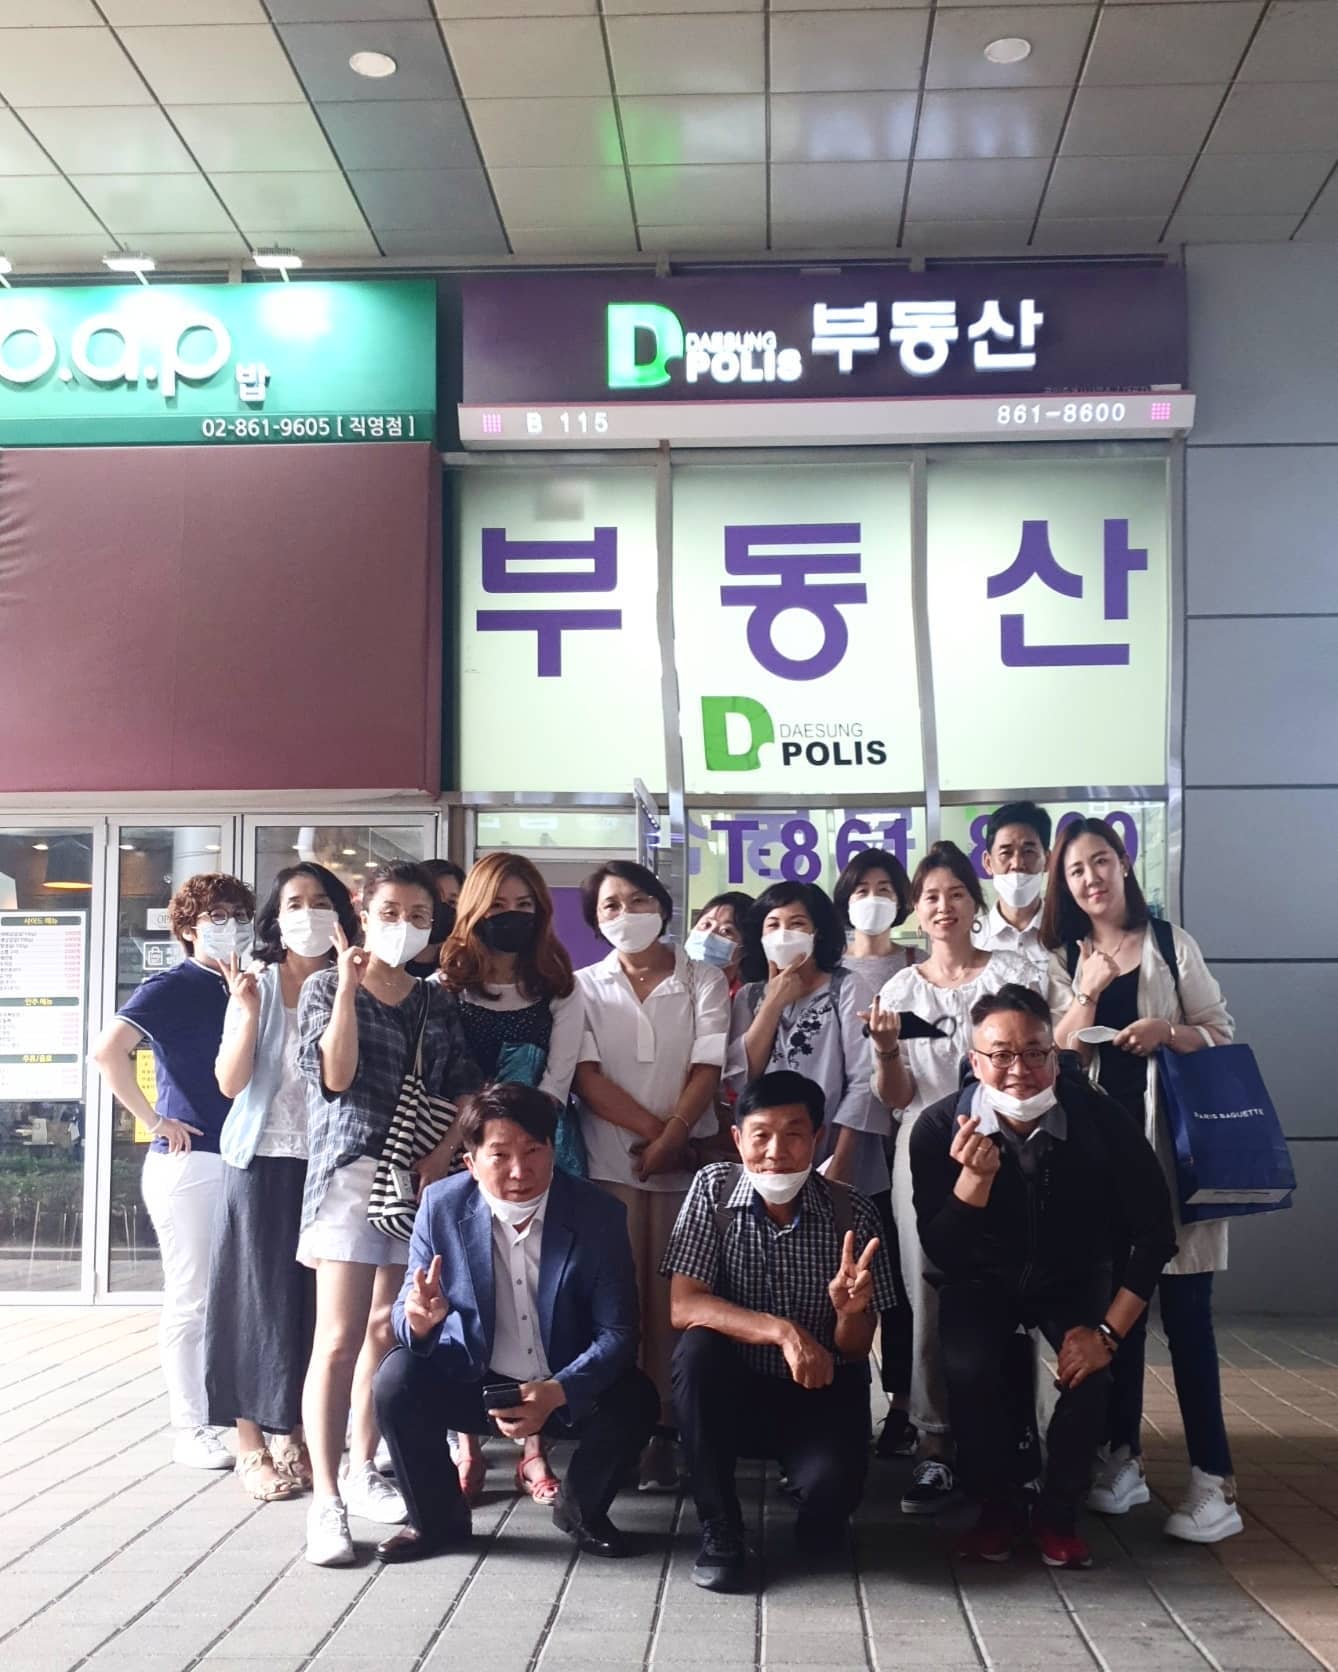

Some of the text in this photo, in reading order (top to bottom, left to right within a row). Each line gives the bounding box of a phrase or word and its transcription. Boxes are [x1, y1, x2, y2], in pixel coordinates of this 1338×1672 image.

[686, 331, 777, 352] DAESUNG
[811, 299, 1044, 377] 부동산
[686, 348, 803, 383] POLIS
[236, 363, 271, 402] 밥
[526, 411, 609, 433] B 115
[997, 402, 1126, 424] 861-8600
[202, 417, 330, 437] 02-861-9605
[350, 415, 403, 437] 직영점
[779, 723, 864, 738] DAESUNG
[782, 741, 888, 766] POLIS
